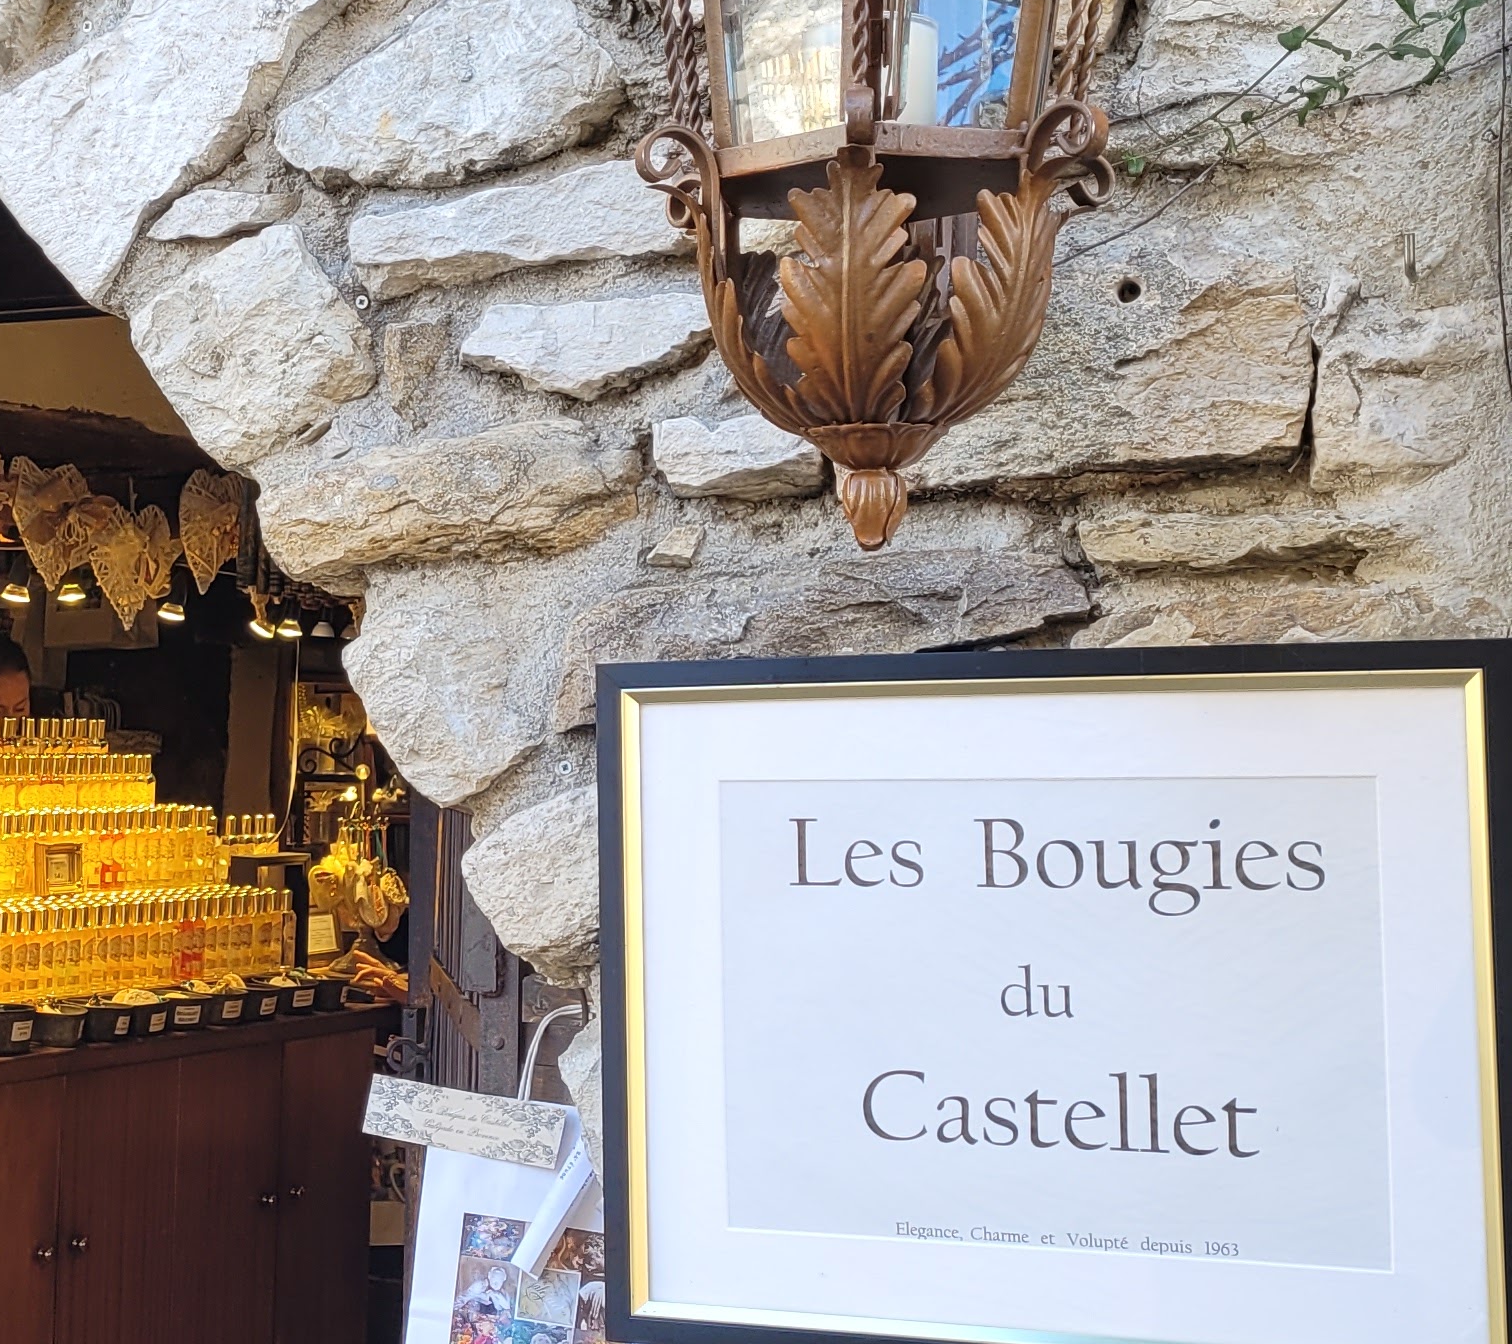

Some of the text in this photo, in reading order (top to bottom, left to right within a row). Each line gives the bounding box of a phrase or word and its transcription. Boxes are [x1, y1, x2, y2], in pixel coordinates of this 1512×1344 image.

[788, 817, 1326, 917] Les Bougies
[999, 963, 1075, 1019] du
[862, 1069, 1261, 1159] Castellet
[895, 1221, 1239, 1257] Elegance, Charme et Volupté depuis 1963
